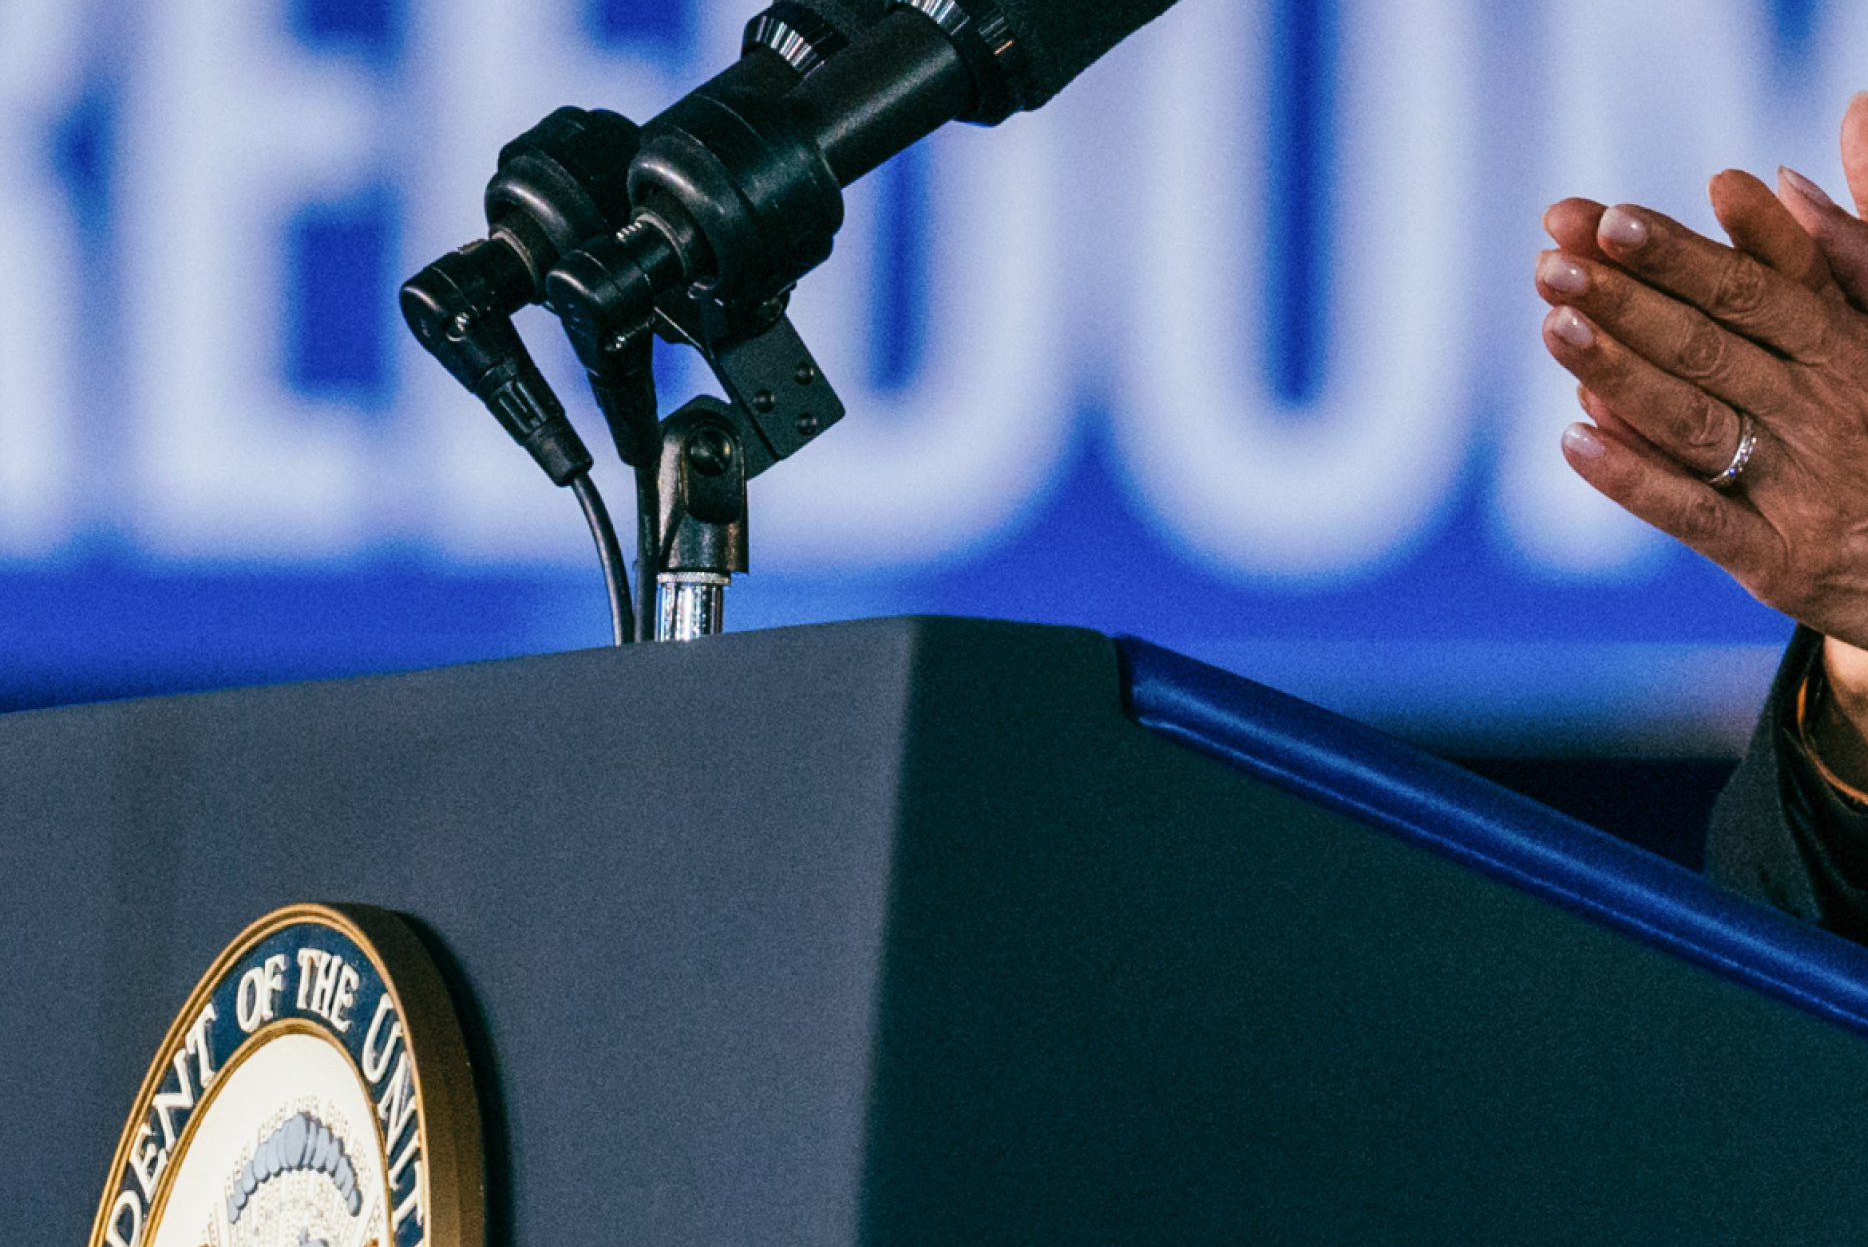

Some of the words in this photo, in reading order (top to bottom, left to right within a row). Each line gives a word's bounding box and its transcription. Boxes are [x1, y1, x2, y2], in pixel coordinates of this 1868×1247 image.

[236, 954, 286, 1033] OF
[296, 947, 360, 1033] THE
[362, 992, 425, 1247] UNIT
